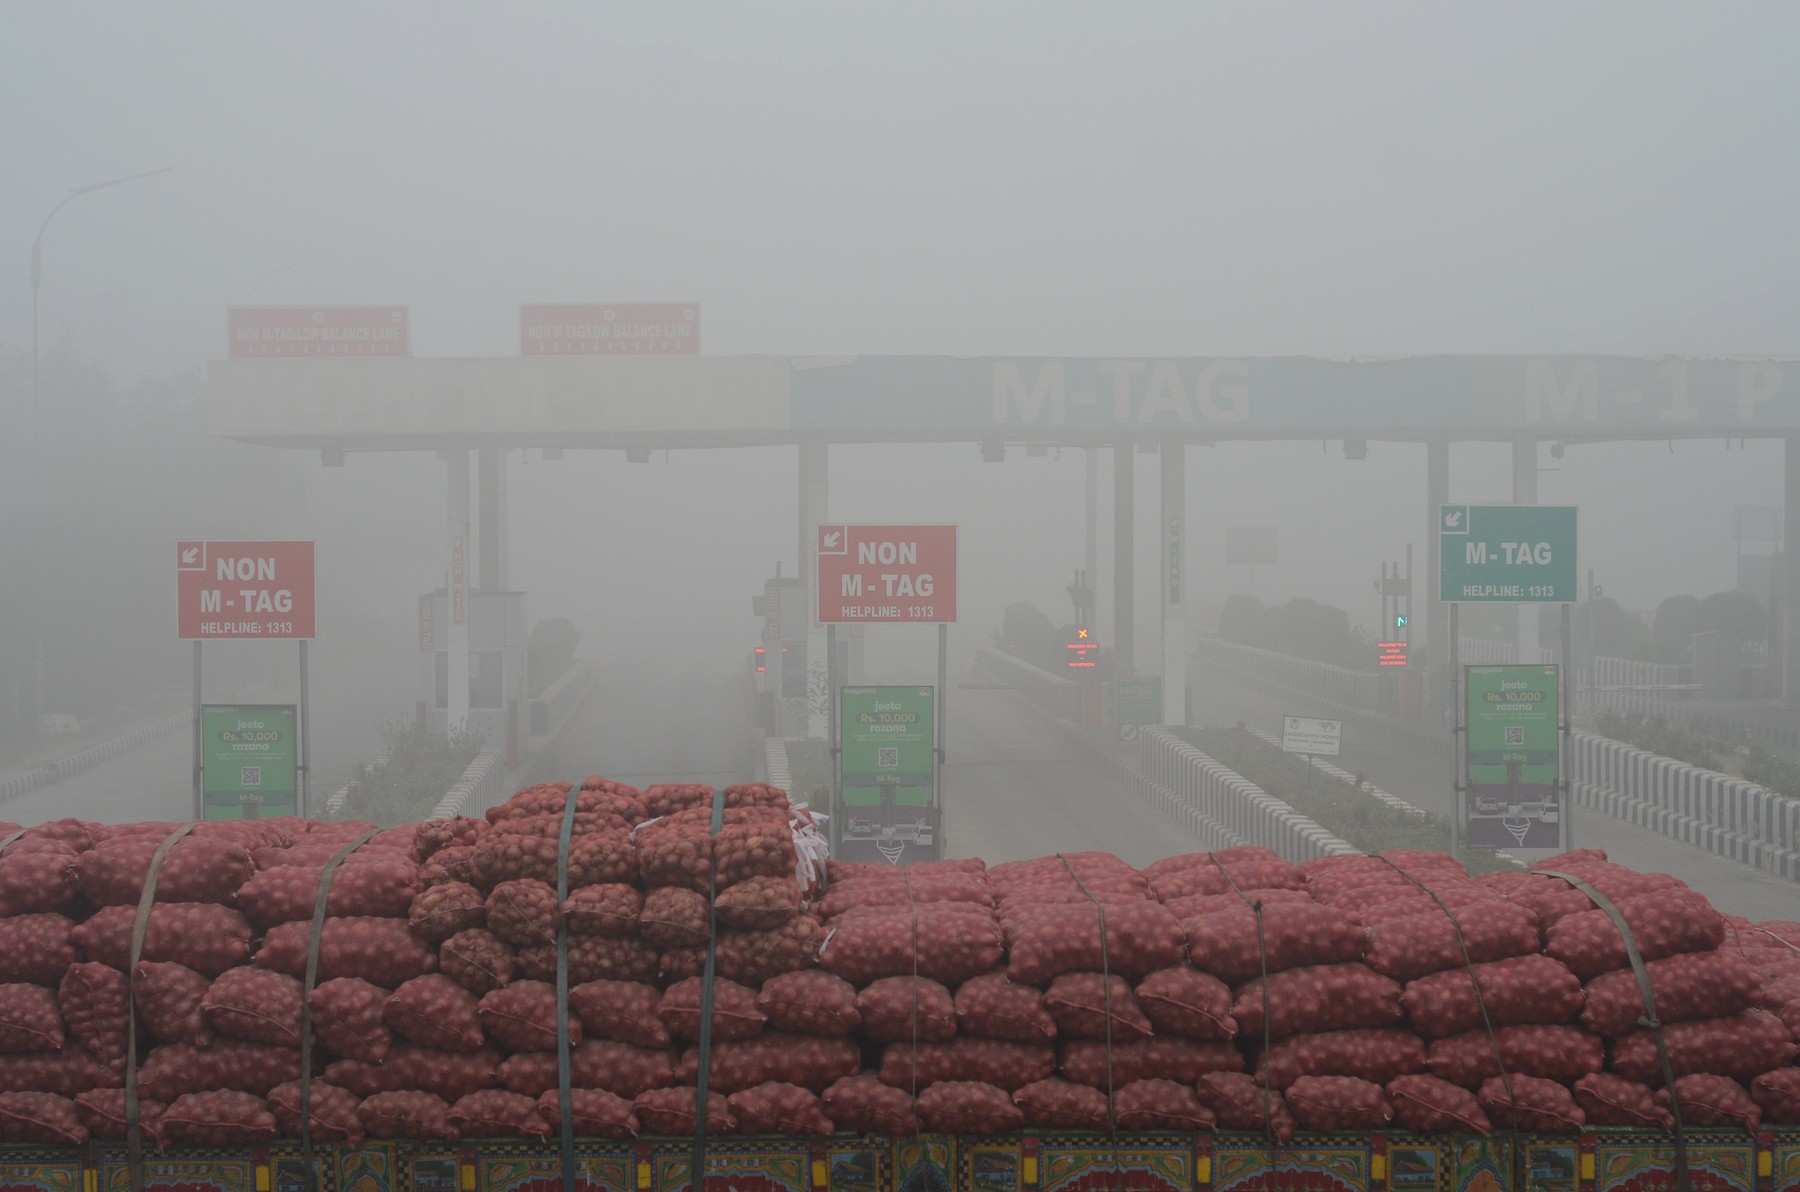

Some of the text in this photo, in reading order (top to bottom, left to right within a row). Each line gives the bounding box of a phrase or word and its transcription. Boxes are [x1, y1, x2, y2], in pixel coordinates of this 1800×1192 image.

[238, 328, 258, 342] NON
[322, 328, 368, 340] BALANCE
[374, 328, 400, 340] LANE
[528, 326, 550, 338] NON
[614, 324, 662, 337] BALANCE
[665, 324, 692, 337] LANE
[858, 542, 917, 565] NON
[216, 557, 275, 581] NON
[1464, 586, 1554, 597] HELPLINE: 1313
[842, 606, 934, 618] HELPLINE: 1313
[201, 622, 293, 634] HELPLINE: 1313
[1501, 680, 1527, 691] jeeto
[1487, 692, 1502, 701] Rs.
[875, 701, 901, 712] jeeto
[860, 714, 876, 722] Rs.
[237, 720, 264, 730] jeeto
[870, 724, 906, 732] rozana
[223, 732, 238, 741] Rs.
[232, 743, 268, 751] rozana
[1504, 754, 1527, 762] M-Tag
[876, 775, 901, 783] M-Tag
[240, 794, 264, 802] M-Tag
